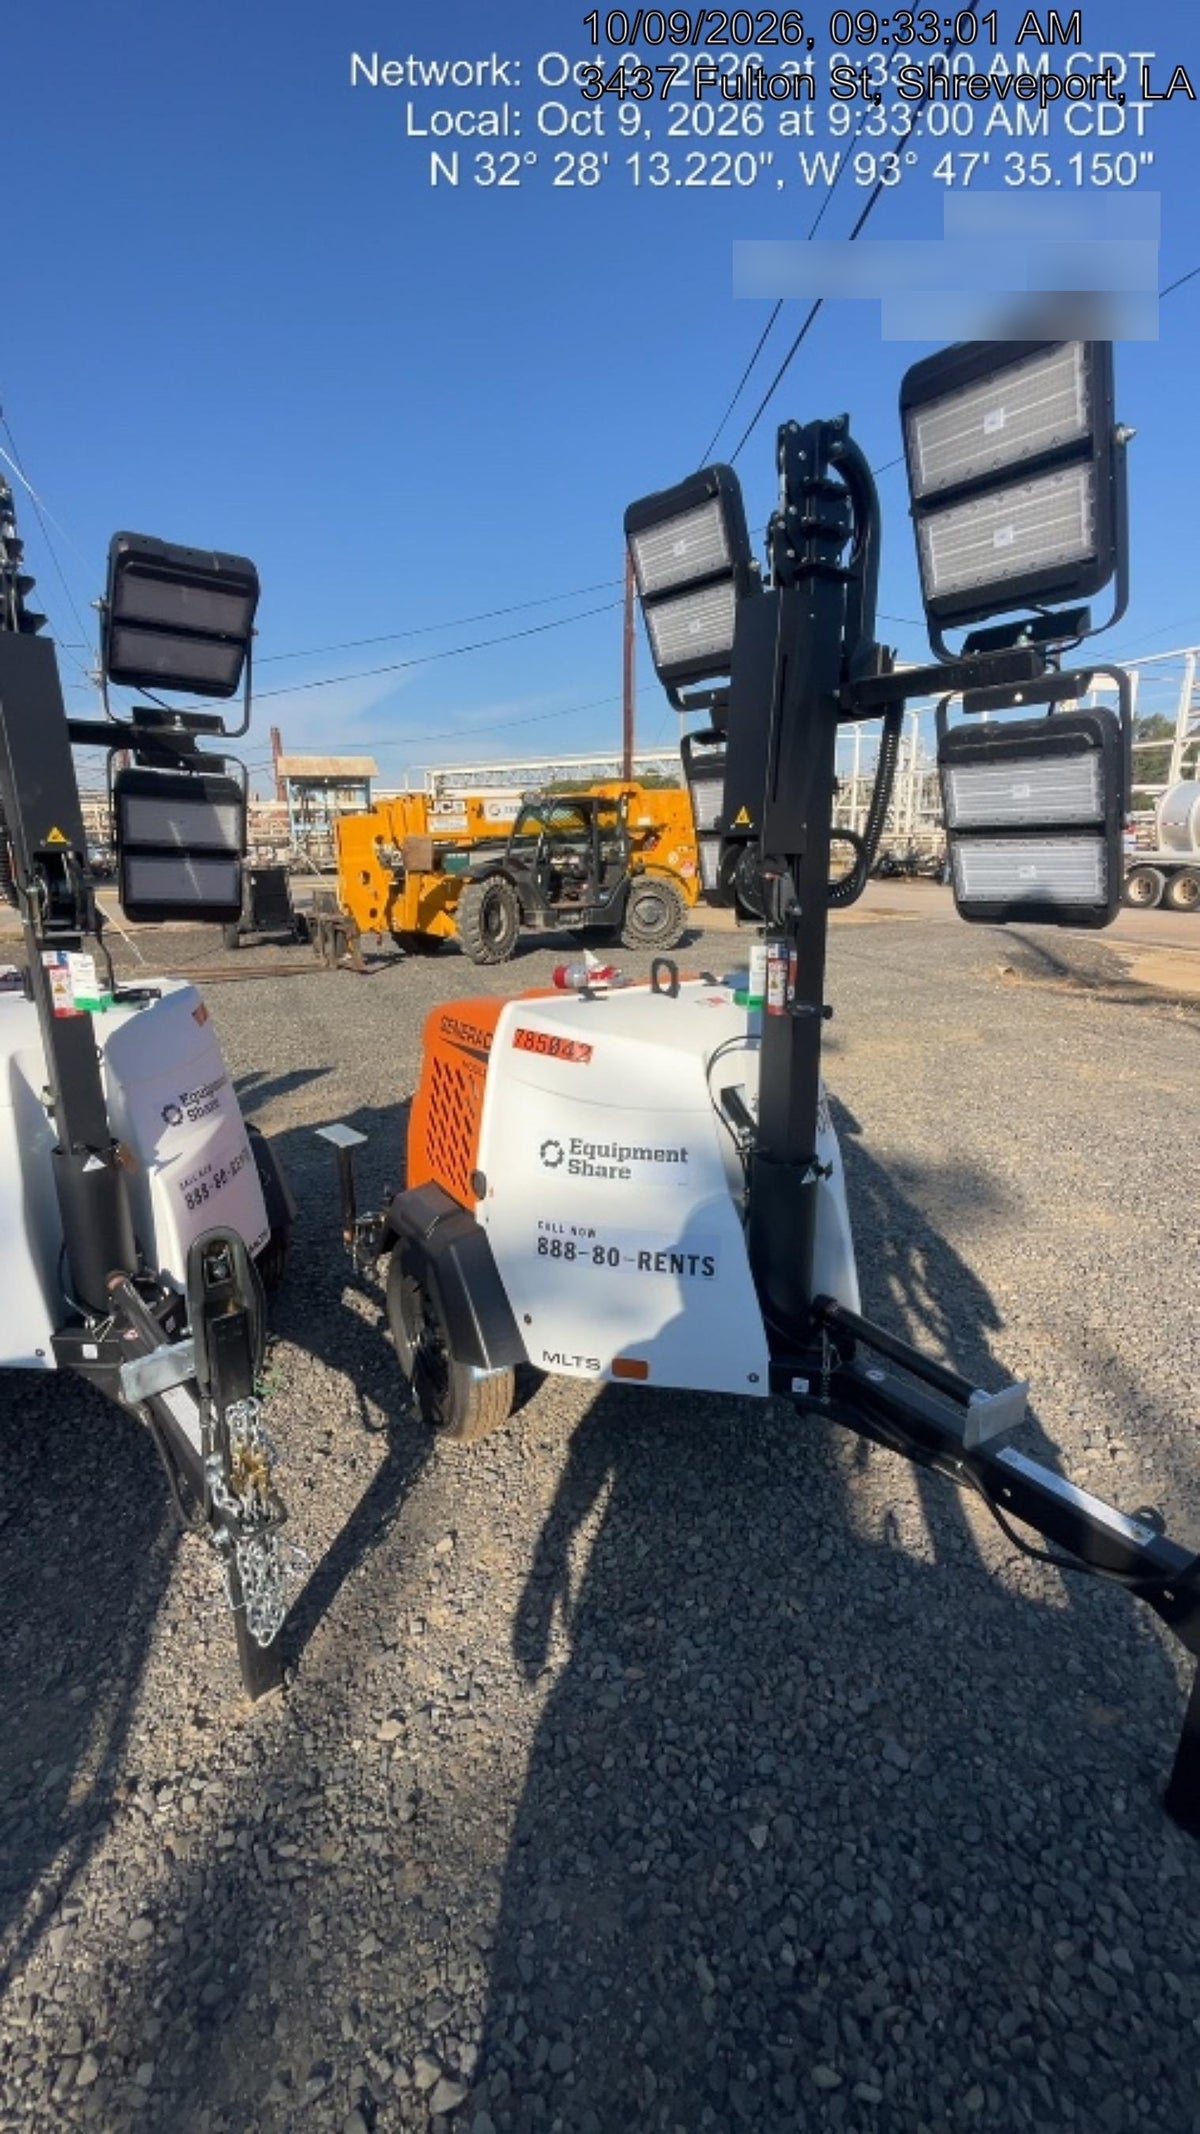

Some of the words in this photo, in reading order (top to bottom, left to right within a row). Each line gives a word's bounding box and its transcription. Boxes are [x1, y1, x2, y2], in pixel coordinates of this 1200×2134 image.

[568, 1138, 688, 1163] Equipment
[568, 1159, 632, 1180] Share
[537, 1237, 716, 1277] 888-80-RENTS
